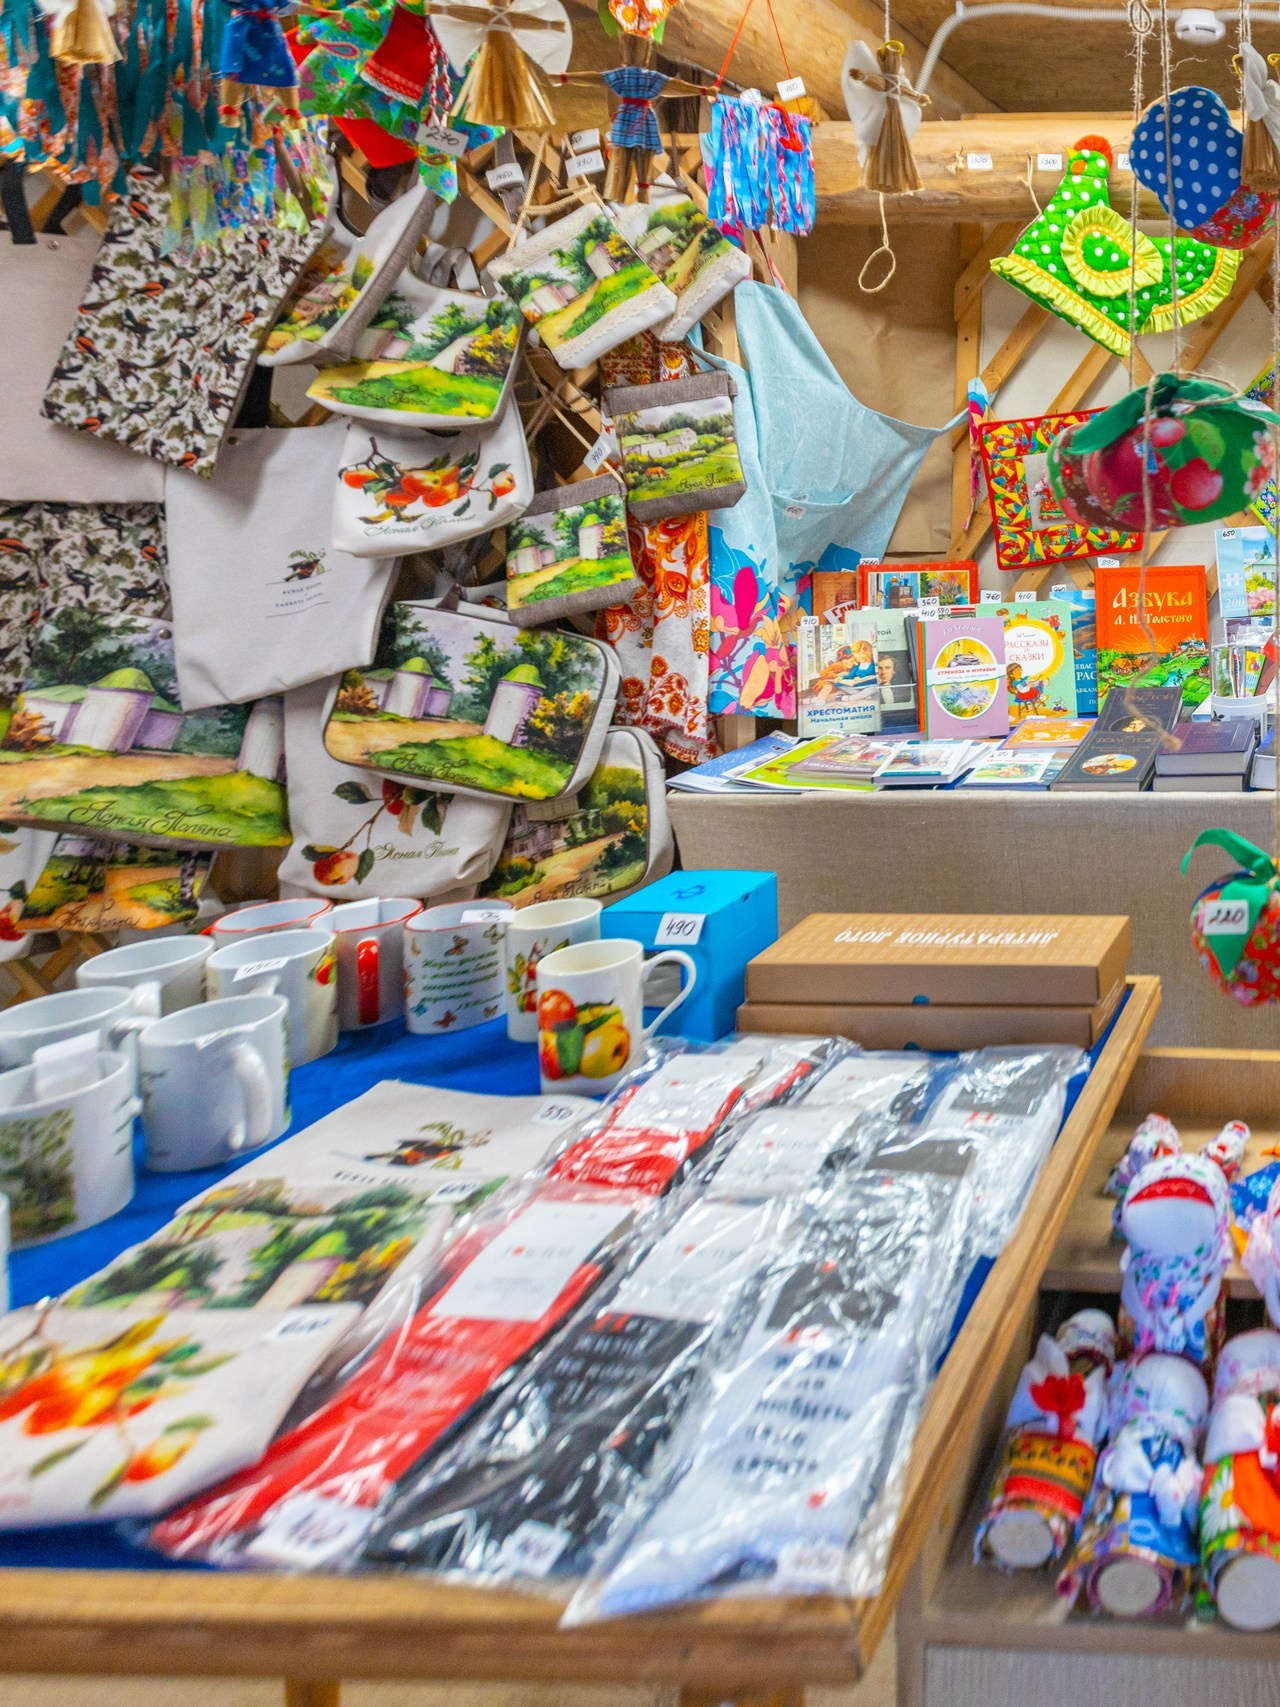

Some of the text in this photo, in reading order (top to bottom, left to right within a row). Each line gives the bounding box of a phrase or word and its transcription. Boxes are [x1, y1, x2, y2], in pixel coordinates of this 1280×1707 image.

[426, 126, 460, 147] 270
[985, 593, 1001, 601] 760
[921, 609, 935, 618] 410
[1009, 653, 1045, 662] СКАЗКИ
[806, 704, 876, 717] ХРЕСТОМАТИЯ
[810, 713, 872, 724] Начальная школа
[150, 804, 243, 839] Поляна
[1208, 908, 1245, 925] 220
[664, 919, 697, 938] 490
[833, 930, 1060, 946] ЛИТЕРАТУРНОЕ ЛОТО
[540, 1104, 575, 1121] 550
